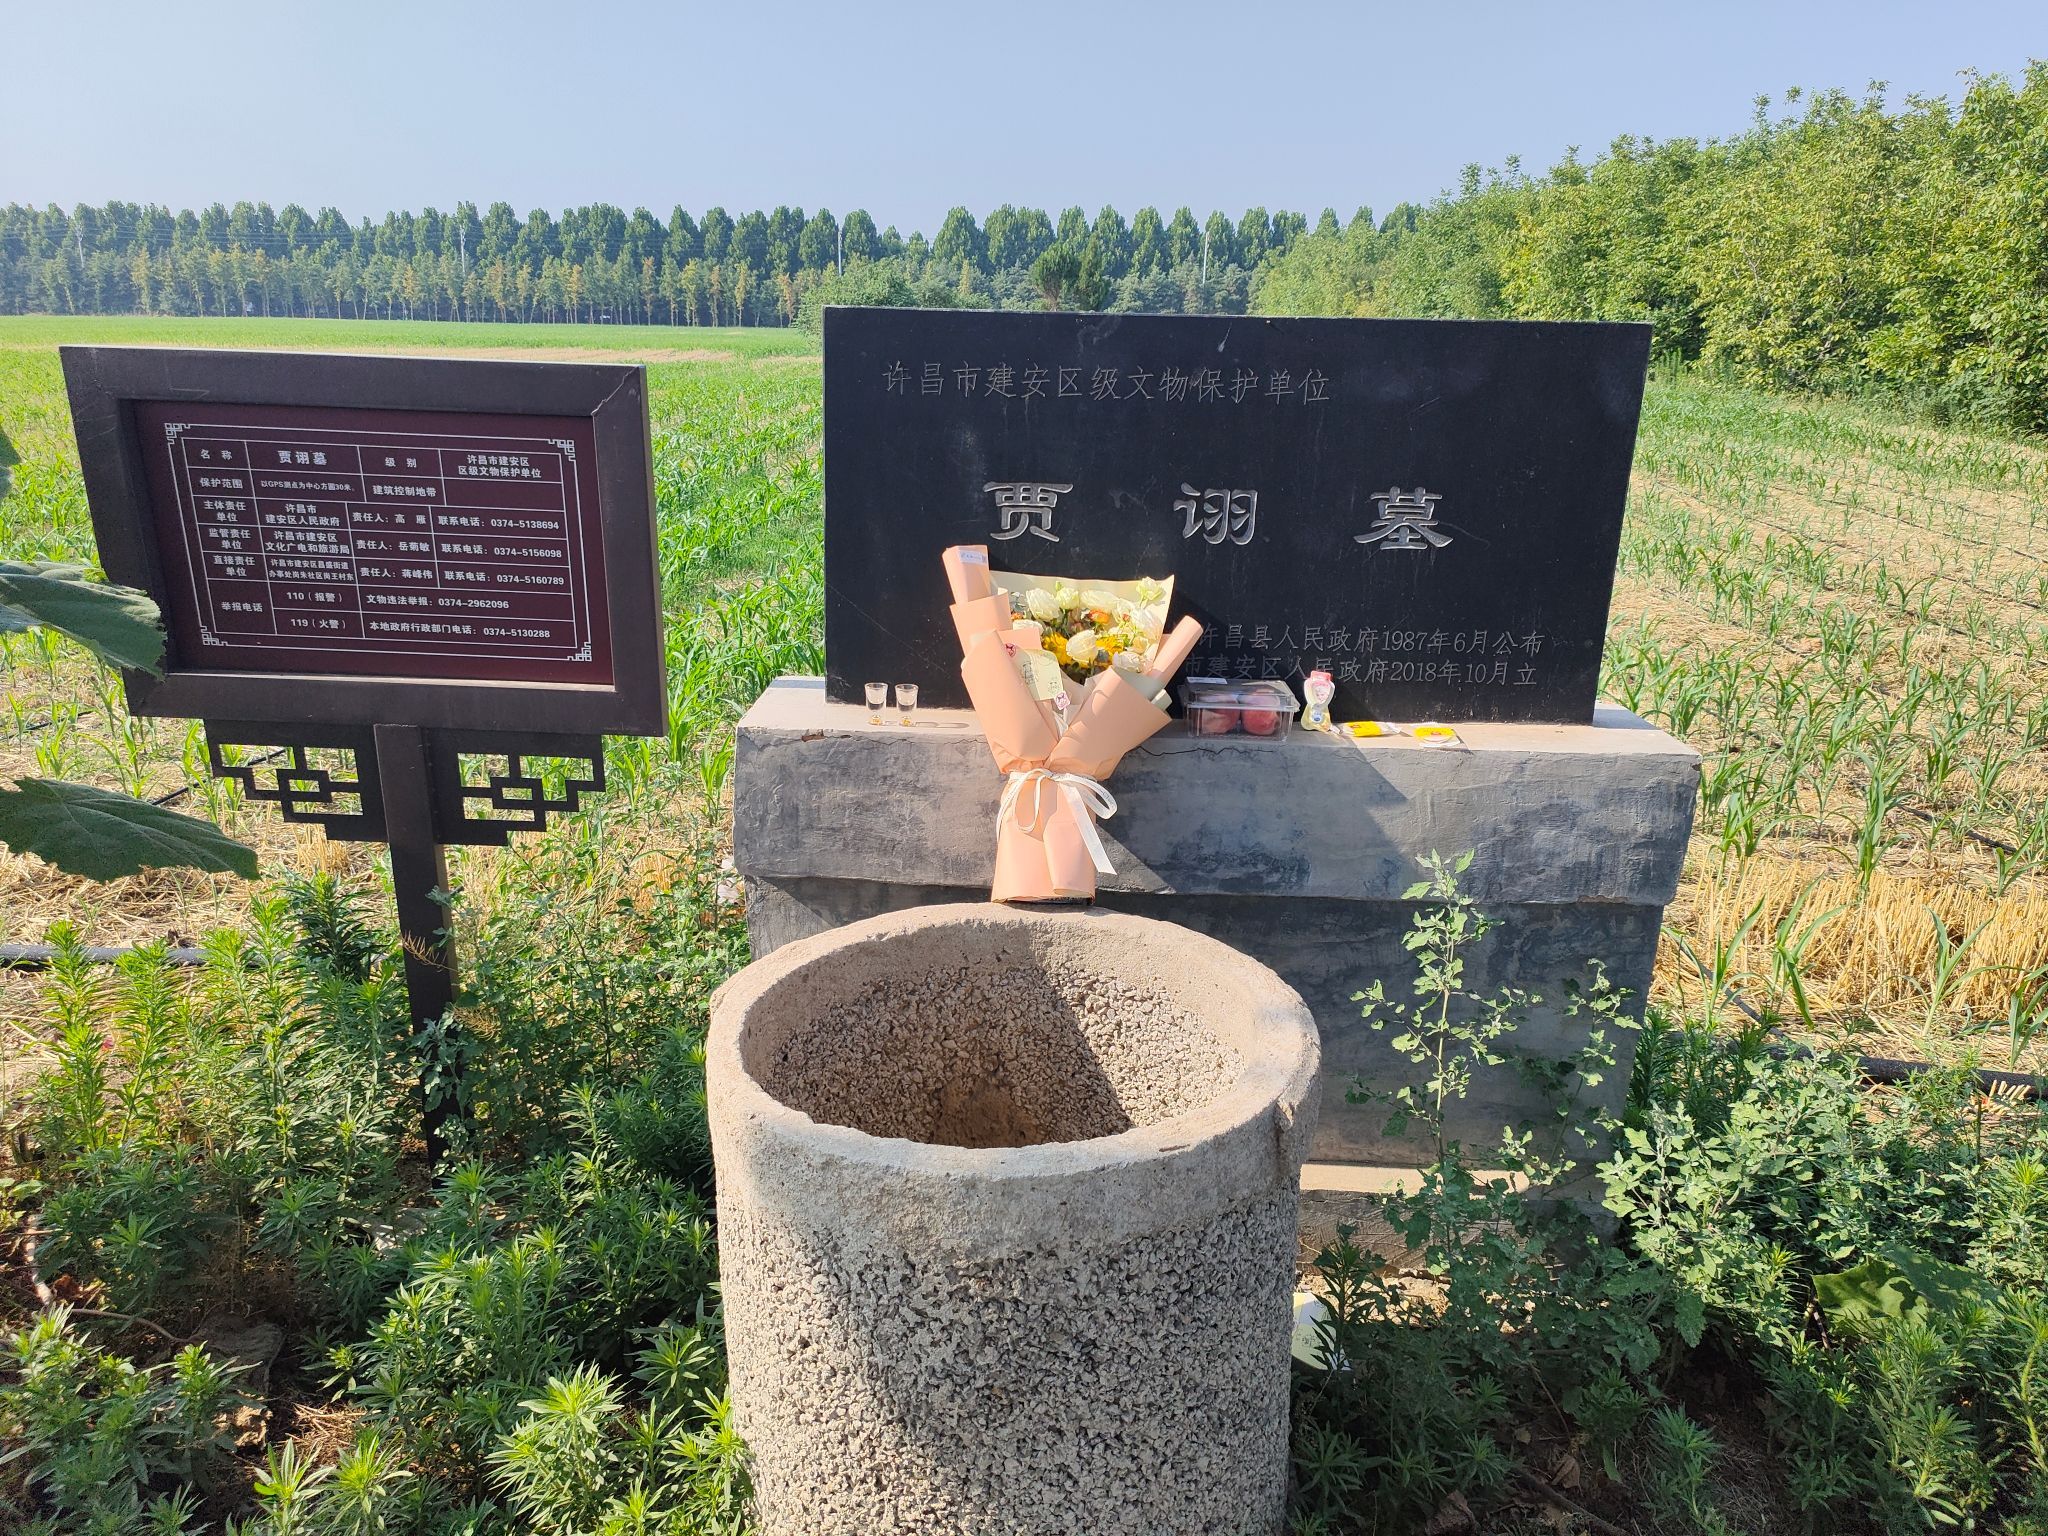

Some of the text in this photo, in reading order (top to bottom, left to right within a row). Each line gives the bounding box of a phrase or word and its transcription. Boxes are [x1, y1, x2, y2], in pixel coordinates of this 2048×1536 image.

[881, 361, 1330, 405] 许昌市建安区级文物保护单位
[200, 449, 233, 461] 名称
[277, 450, 328, 466] 贾诩墓
[467, 454, 530, 467] 许昌市建安区
[385, 457, 417, 468] 级别
[458, 466, 542, 479] 区级文物保护单位
[200, 478, 243, 489] 保护范围
[372, 485, 437, 498] 建筑控制地带
[203, 501, 246, 511] 主体责任
[285, 503, 317, 514] 许昌市
[216, 512, 238, 522] 单位
[265, 514, 340, 527] 建安区人民政府
[983, 481, 1453, 550] 贾诩墓
[208, 528, 251, 539] 监管责任
[273, 530, 338, 543] 许昌市建安区
[221, 540, 243, 550] 单位
[265, 542, 350, 555] 文化广电和旅游局
[213, 555, 256, 566] 直接责任
[226, 567, 248, 577] 单位
[221, 602, 263, 613] 举报电话
